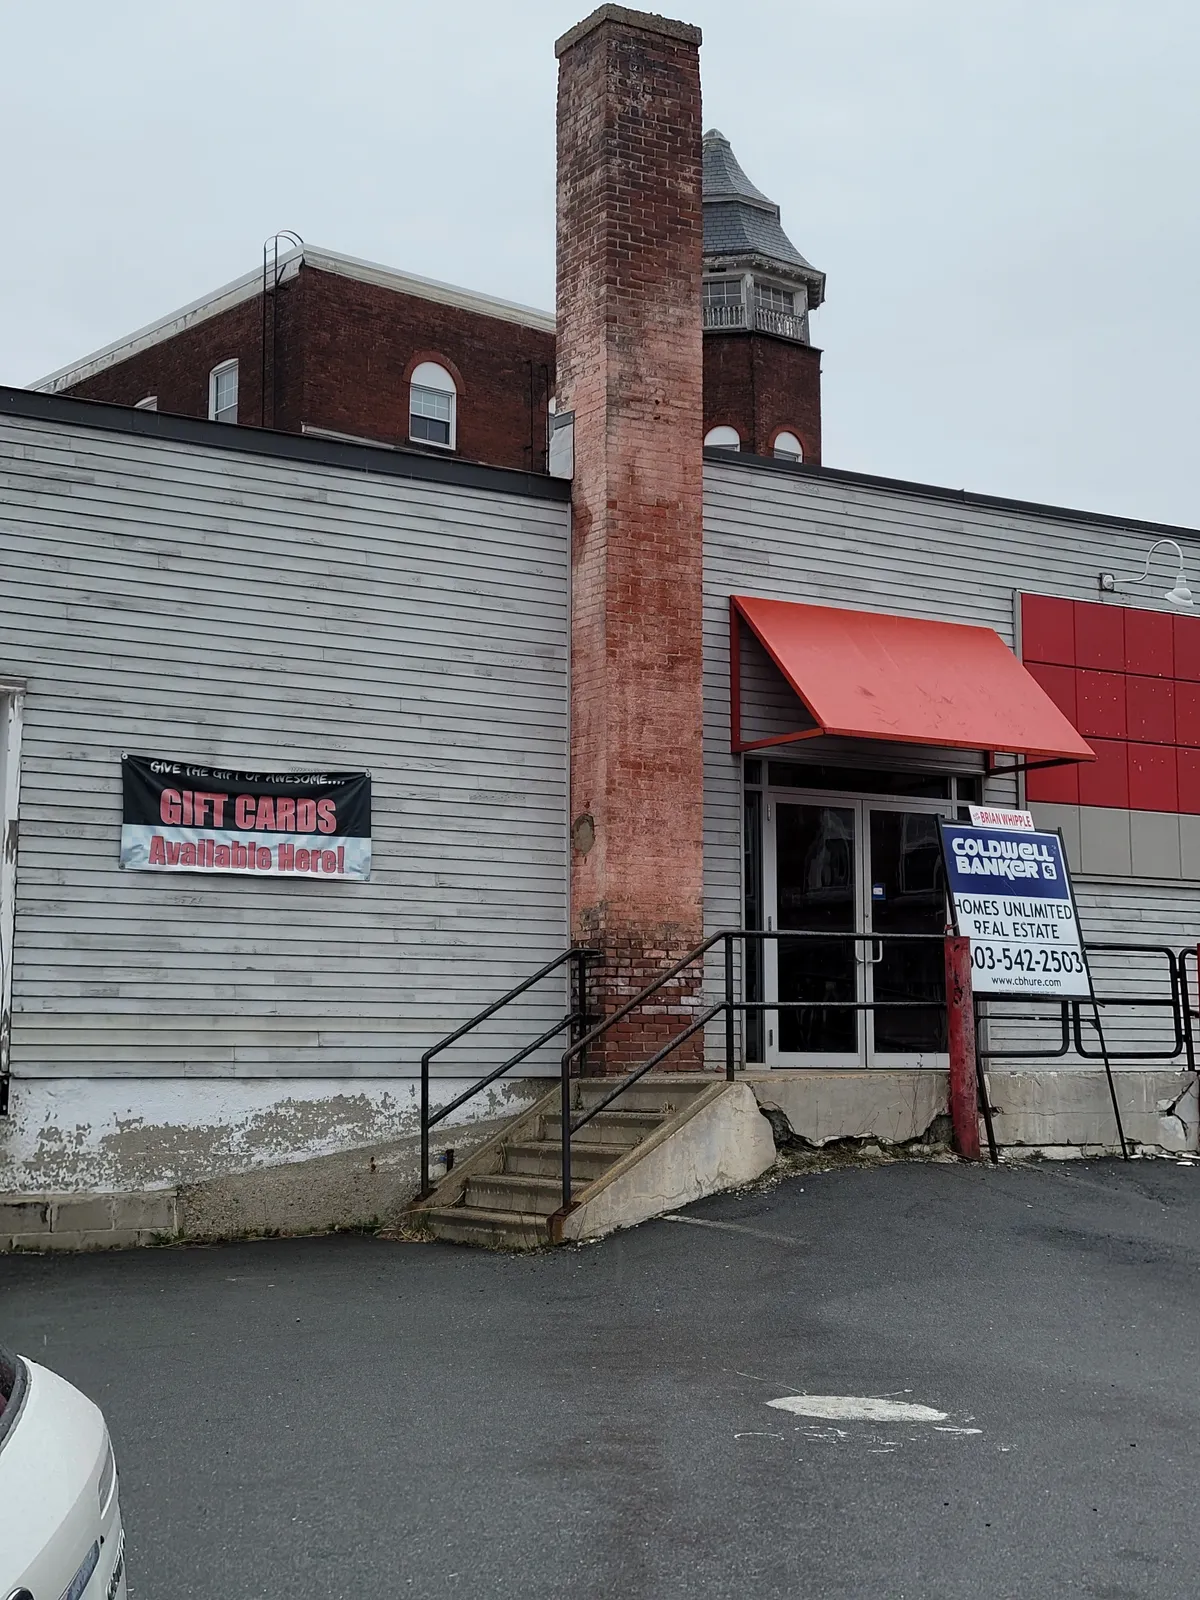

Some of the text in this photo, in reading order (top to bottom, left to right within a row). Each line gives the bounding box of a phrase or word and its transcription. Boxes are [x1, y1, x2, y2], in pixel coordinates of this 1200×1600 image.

[150, 761, 181, 774] GIVE
[186, 765, 209, 777] THE
[160, 788, 337, 834] GIFT CARDS
[980, 811, 1001, 825] BRIAN
[1001, 813, 1032, 828] WHIPPLE
[149, 835, 345, 874] Available Here!
[952, 837, 1054, 862] COLDWELL
[956, 856, 1040, 880] BANKER
[955, 898, 1073, 920] HOMES UNLIMITED
[973, 920, 1060, 939] REAL ESTATE
[970, 945, 1084, 973] 03-542-2503
[991, 975, 1062, 987] www.cbhure.com
